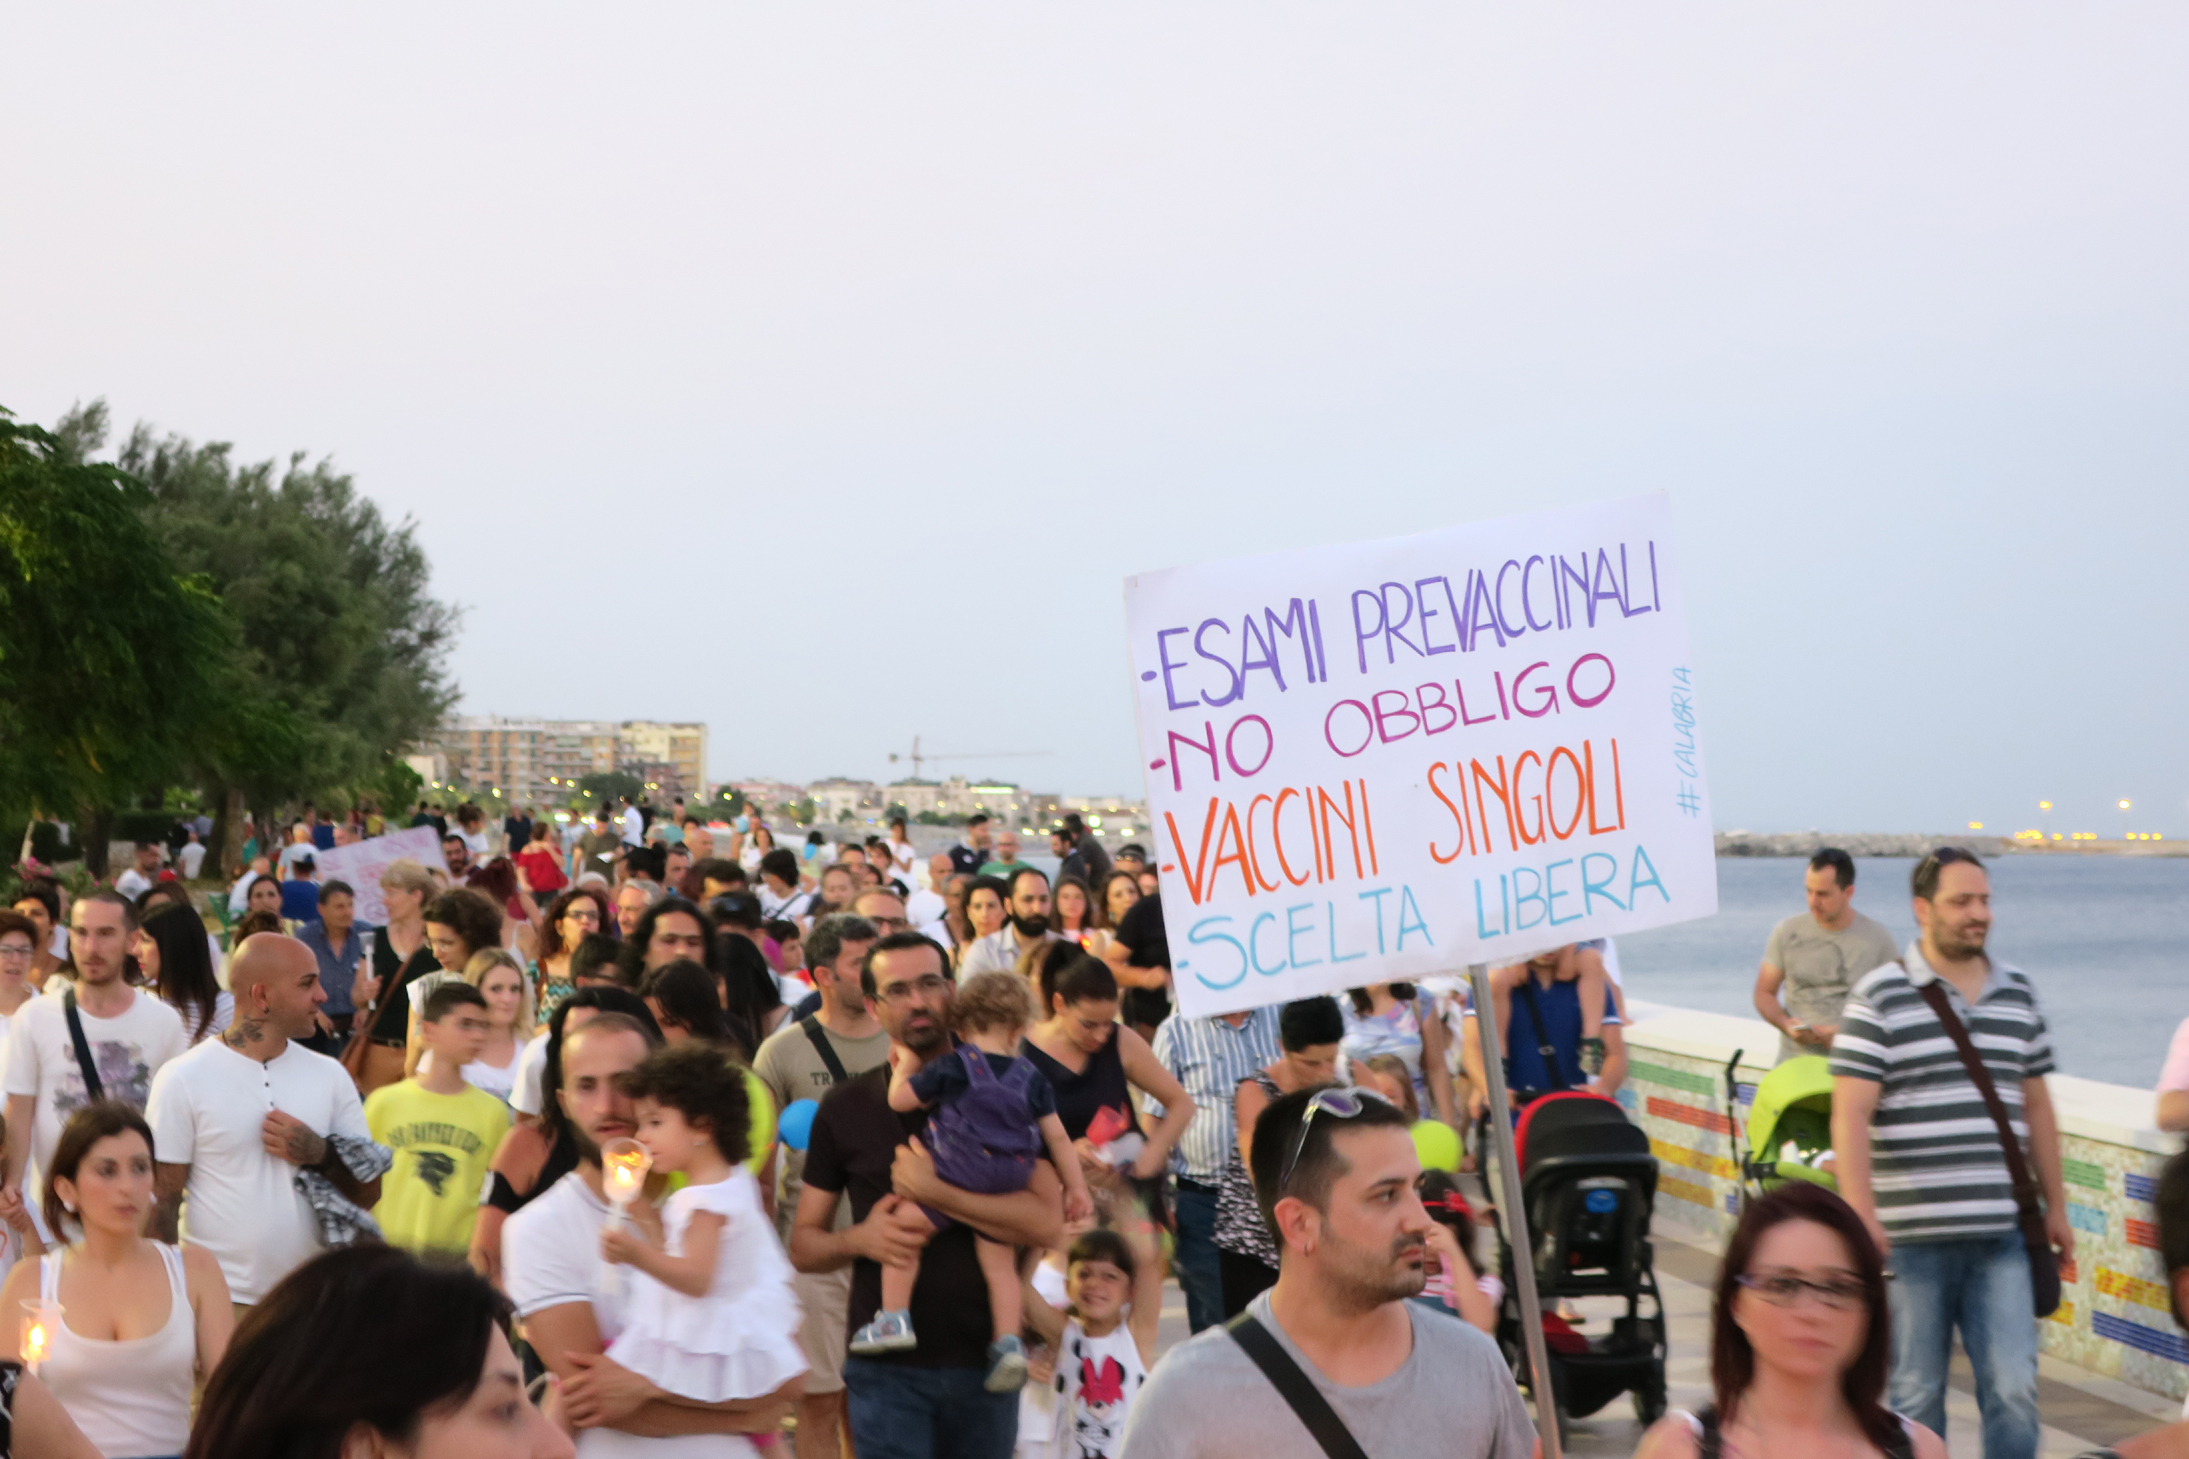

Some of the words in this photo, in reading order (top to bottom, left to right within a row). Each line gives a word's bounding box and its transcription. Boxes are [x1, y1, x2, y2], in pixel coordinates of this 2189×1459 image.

[1351, 540, 1661, 675] PREVACCINALI
[1324, 652, 1616, 758] OBBLIGO
[1671, 666, 1700, 819] #CALABRIA
[1427, 737, 1626, 865] SINGOLI
[1474, 844, 1671, 940] LIBERA
